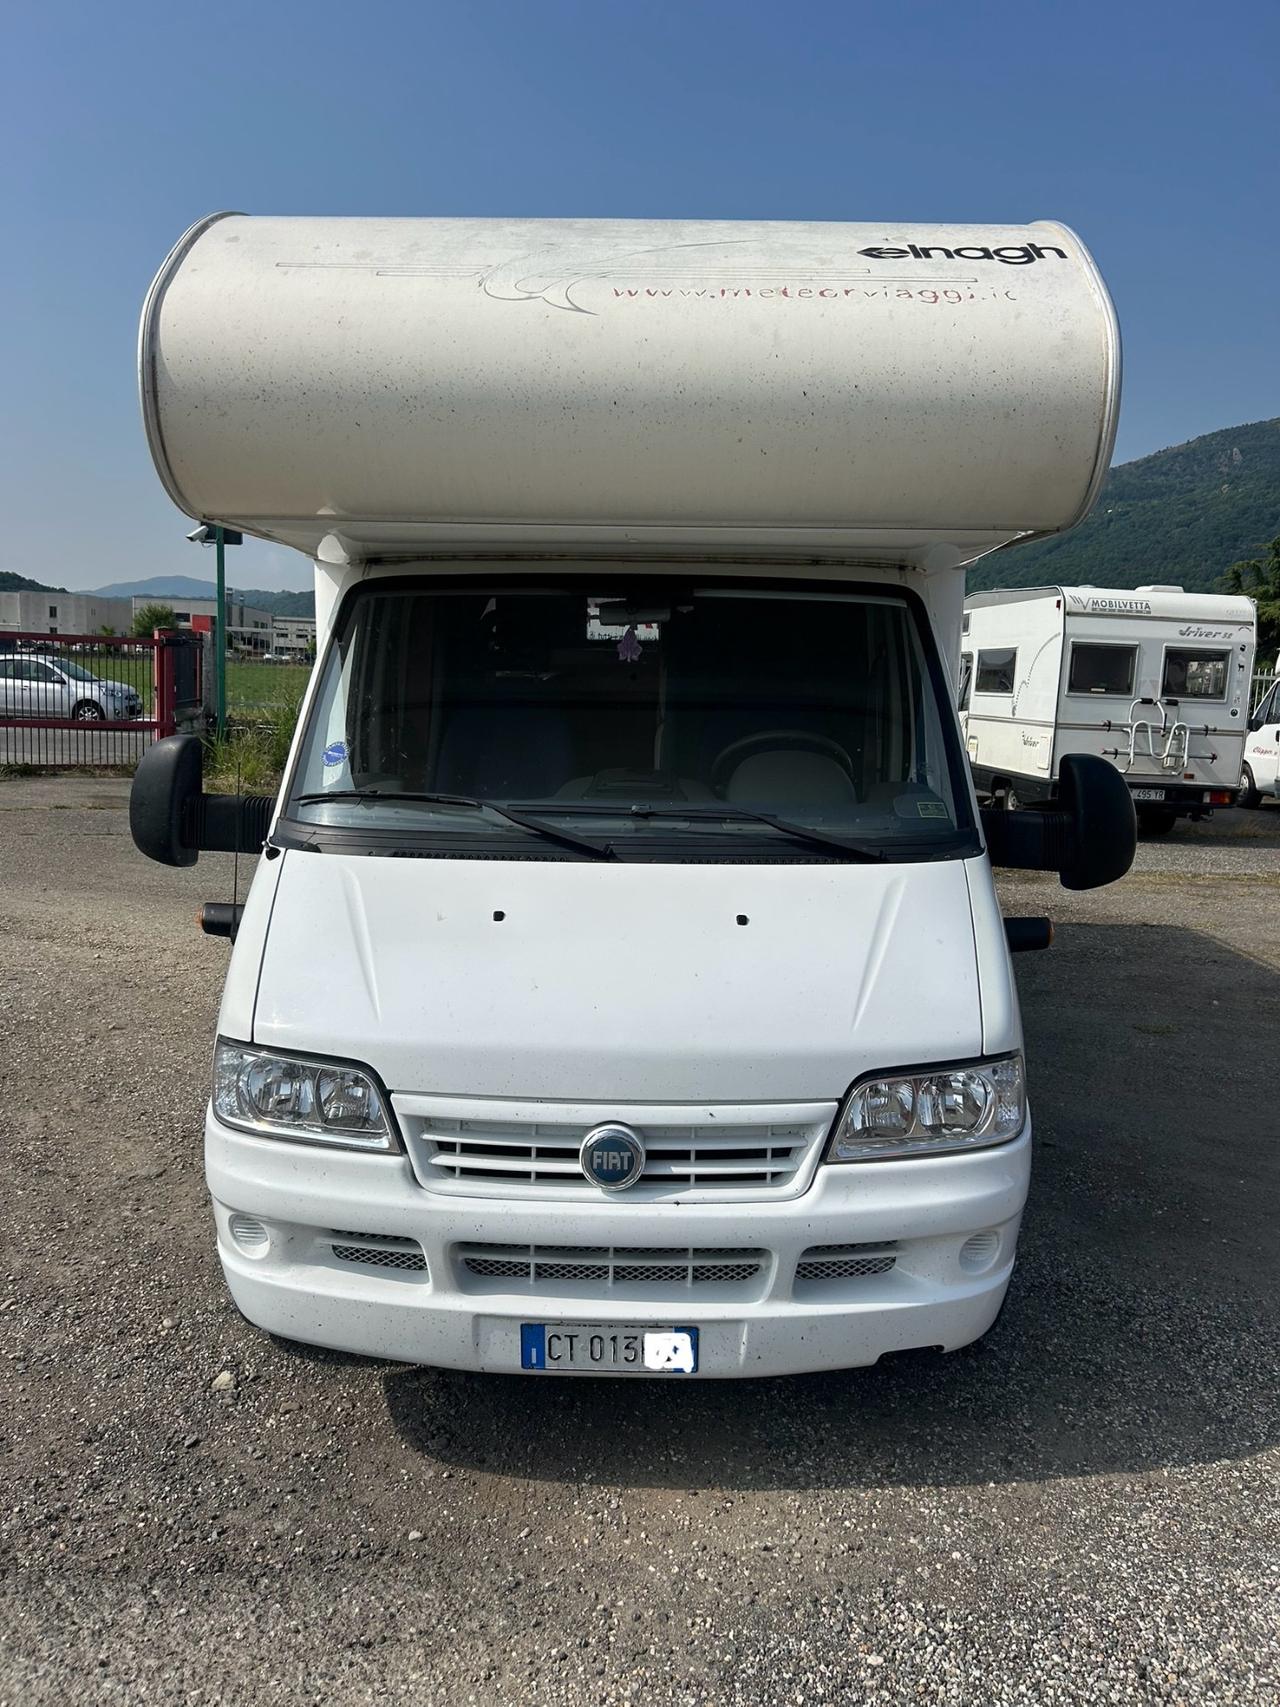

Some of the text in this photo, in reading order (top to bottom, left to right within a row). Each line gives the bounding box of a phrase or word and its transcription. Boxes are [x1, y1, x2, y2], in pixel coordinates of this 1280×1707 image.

[857, 242, 1068, 265] elnagh
[1091, 599, 1151, 611] MOBILVETTA
[592, 1151, 632, 1170] FIAT
[549, 1334, 644, 1363] CT 013
